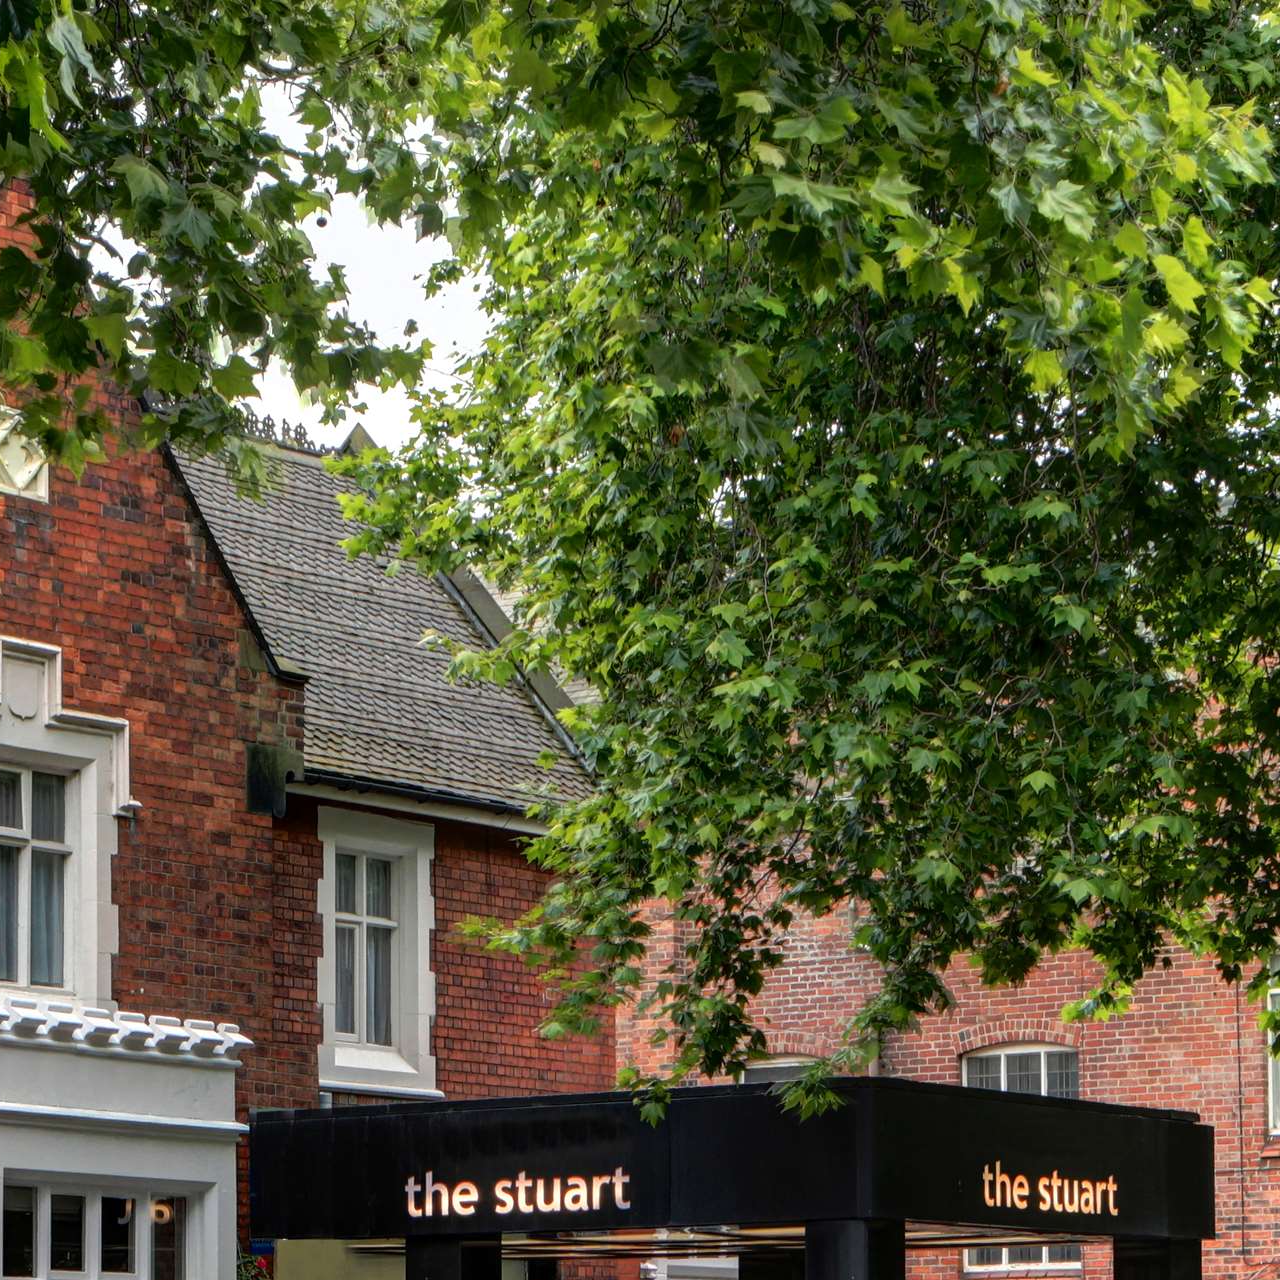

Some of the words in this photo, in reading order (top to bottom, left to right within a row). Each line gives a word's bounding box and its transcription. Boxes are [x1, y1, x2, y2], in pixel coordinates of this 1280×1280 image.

[405, 1170, 479, 1217] the
[494, 1166, 631, 1214] stuart
[982, 1160, 1030, 1210] the
[1038, 1169, 1119, 1217] stuart
